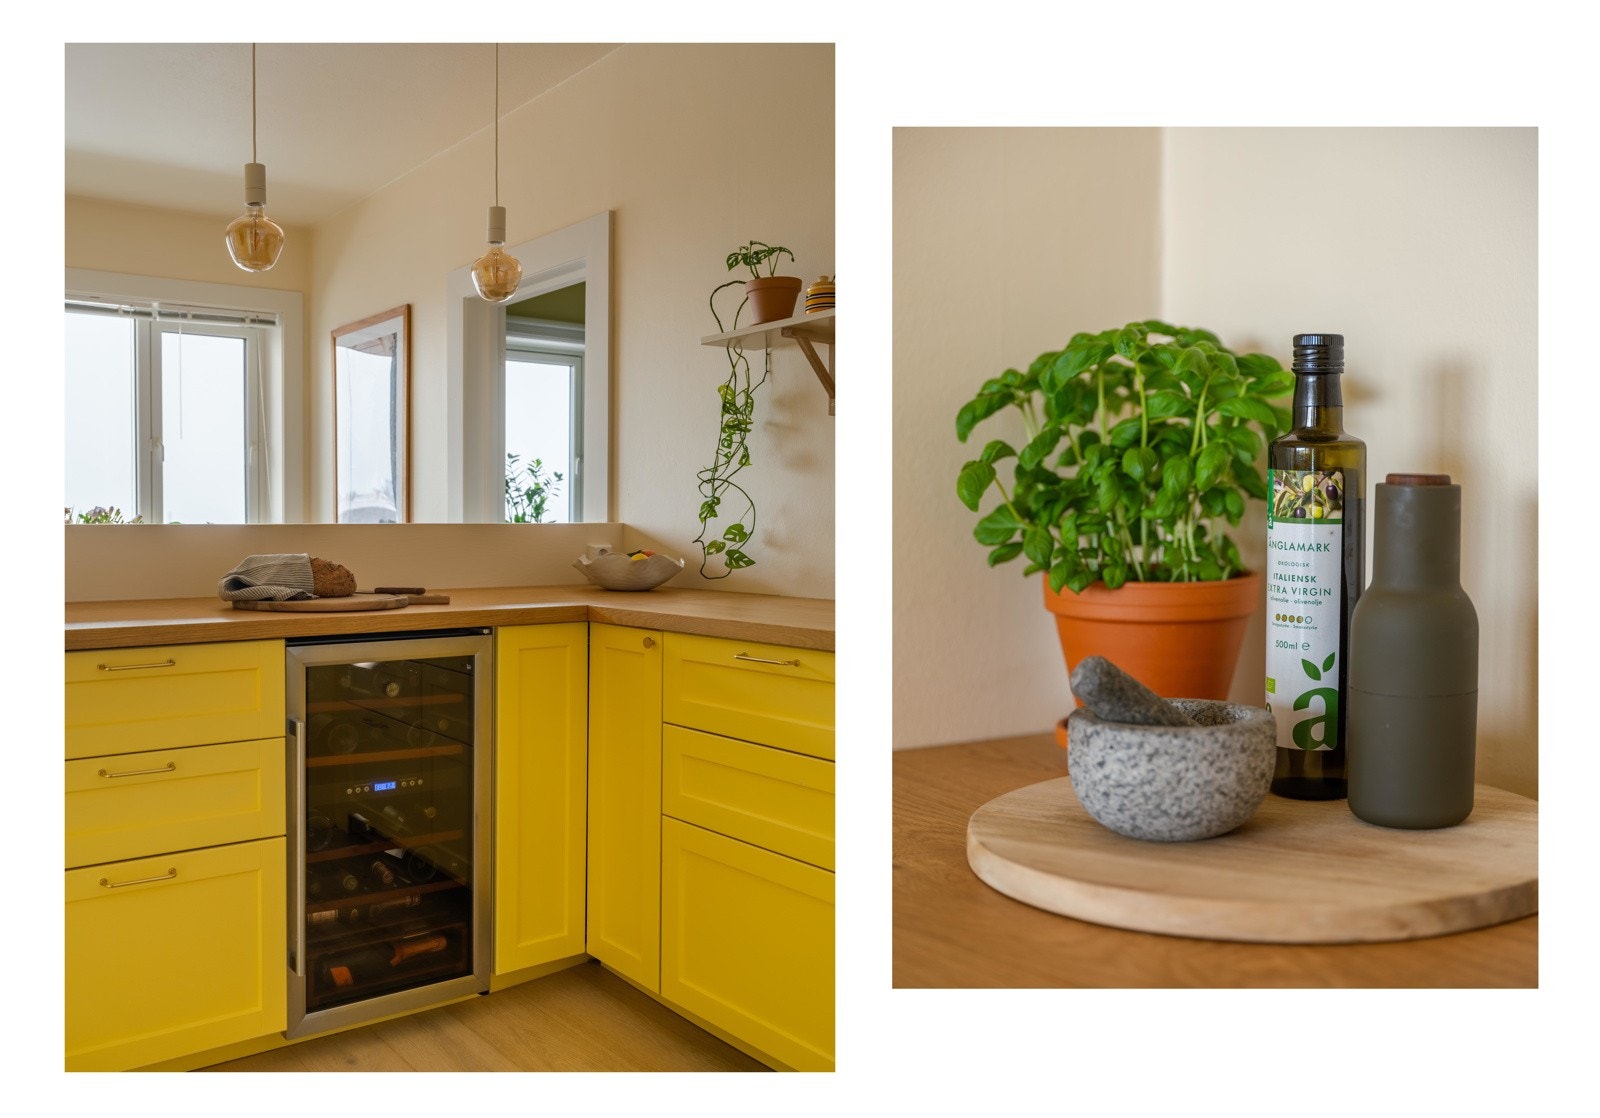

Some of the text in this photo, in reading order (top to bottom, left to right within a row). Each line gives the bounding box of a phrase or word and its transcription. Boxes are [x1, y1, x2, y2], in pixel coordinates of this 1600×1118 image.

[1273, 572, 1317, 583] ITALIENSK
[1268, 582, 1332, 597] EXTRA VIRGIN
[1293, 598, 1323, 607] olivenolje
[1275, 640, 1298, 650] 500ml
